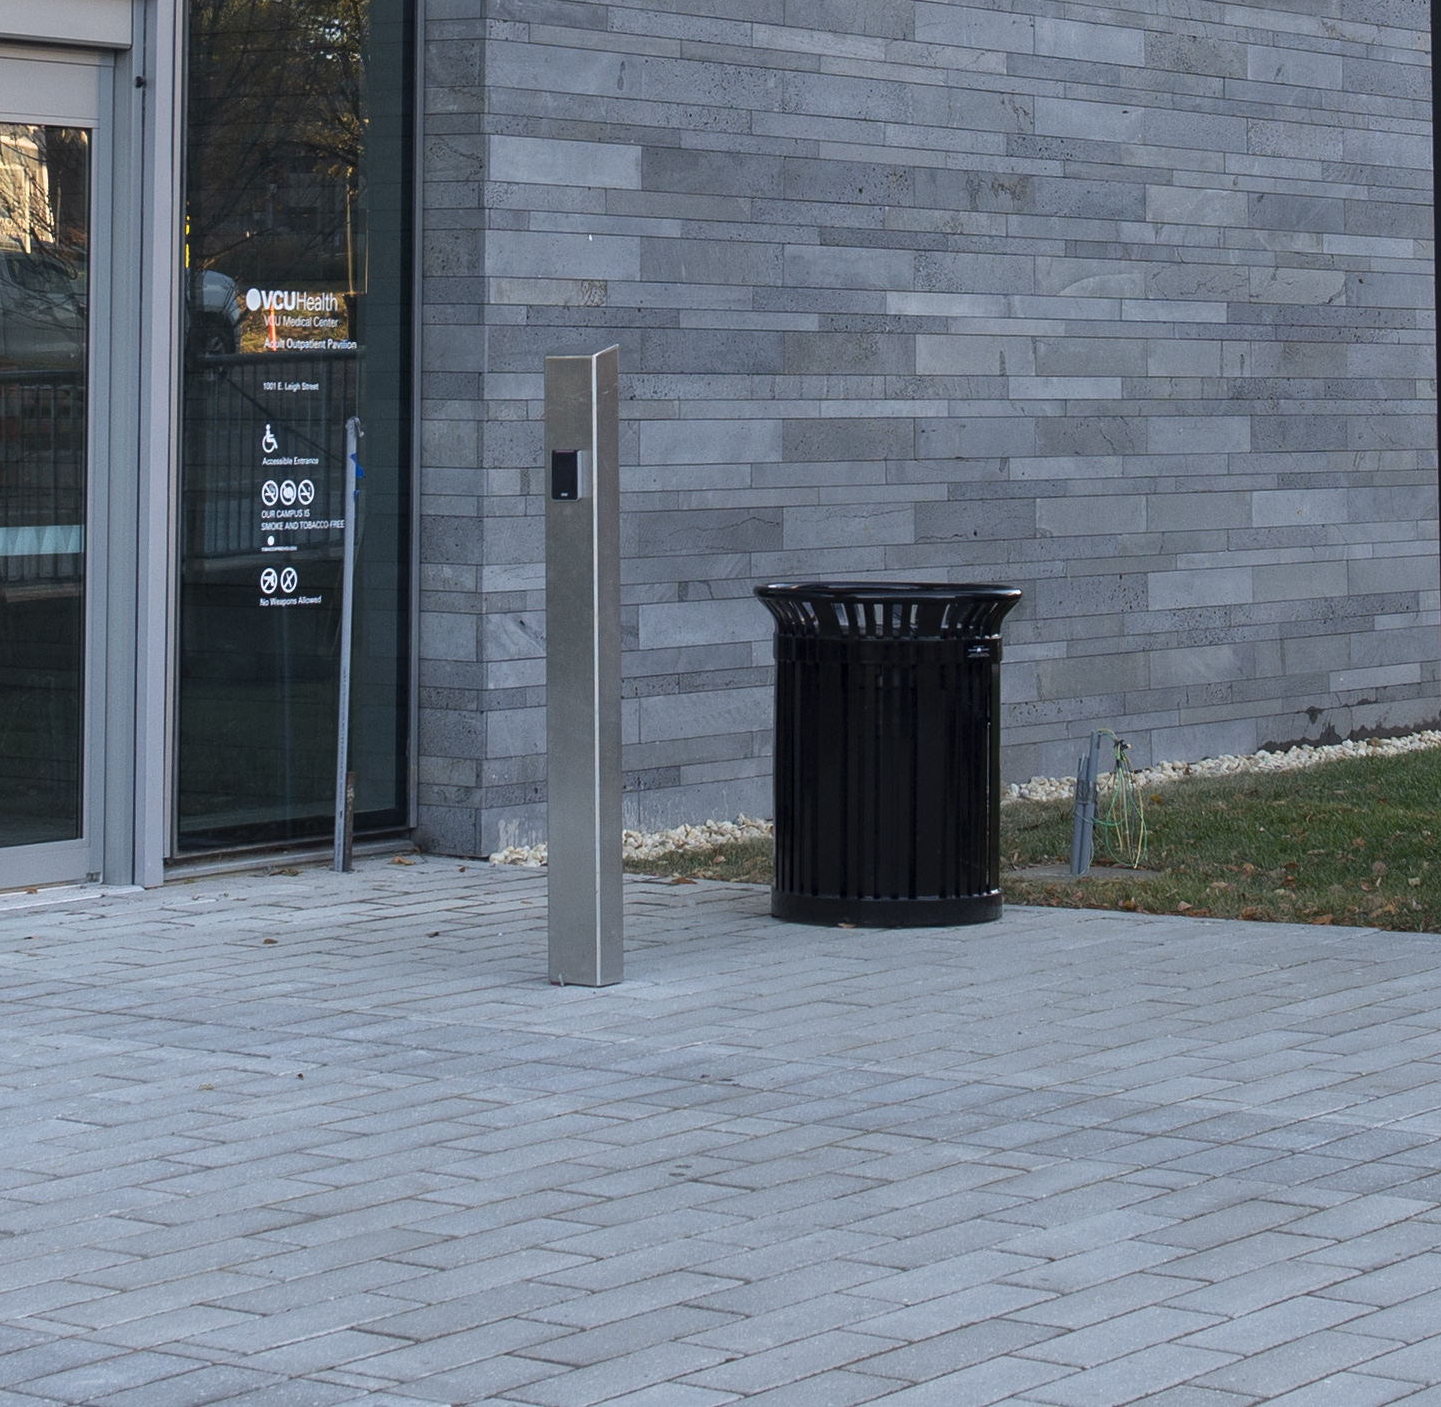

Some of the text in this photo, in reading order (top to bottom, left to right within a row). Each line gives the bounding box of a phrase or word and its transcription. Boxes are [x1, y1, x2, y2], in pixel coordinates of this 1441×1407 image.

[260, 290, 339, 312] VCU Health
[282, 315, 313, 327] Medical
[313, 316, 339, 328] Center
[286, 337, 326, 351] Outpatient
[327, 338, 358, 350] Pavilion
[284, 381, 301, 393] Leigh
[301, 381, 320, 391] Street
[262, 456, 320, 466] Accessible Entrance
[261, 508, 311, 519] OUR CAMPUS IS
[260, 521, 284, 531] SMOKE
[284, 520, 299, 531] AND
[259, 594, 323, 608] No Weapons Allowed
